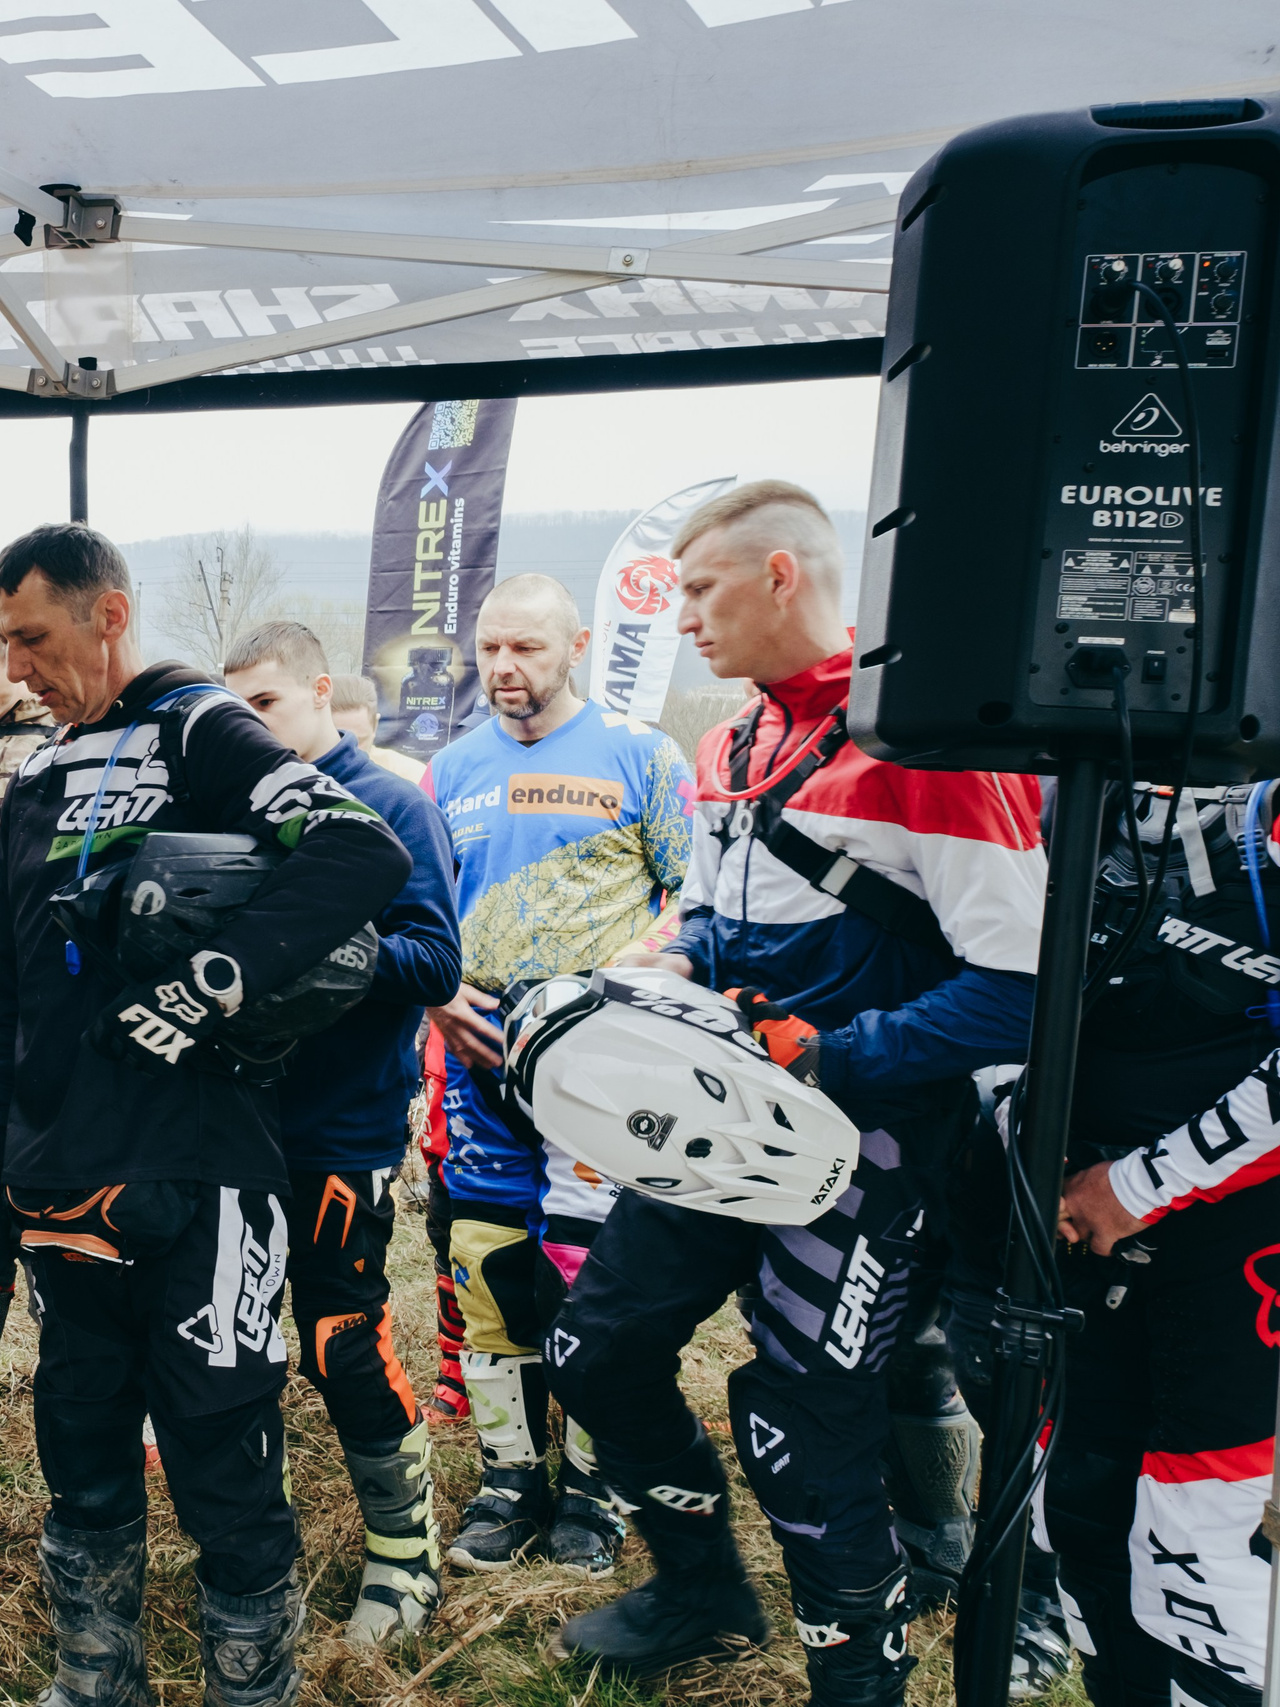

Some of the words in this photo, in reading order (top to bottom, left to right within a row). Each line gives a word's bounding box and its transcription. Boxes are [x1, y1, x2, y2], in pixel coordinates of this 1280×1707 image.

[1099, 440, 1190, 457] behringer
[1061, 485, 1223, 507] EUROLIVE
[448, 498, 465, 571] vitamins
[1092, 510, 1184, 528] B112D
[411, 459, 452, 635] NITREX
[444, 574, 459, 634] Enduro
[406, 696, 446, 706] NITREX
[447, 785, 501, 819] Hard
[511, 784, 619, 810] enduro
[1157, 916, 1236, 955] ATT
[118, 1003, 196, 1065] FOX
[236, 1222, 269, 1352] LEATT
[824, 1234, 896, 1370] LEATT
[331, 1315, 367, 1335] KTM
[771, 1453, 791, 1474] LEATT
[1148, 1527, 1246, 1675] FOX
